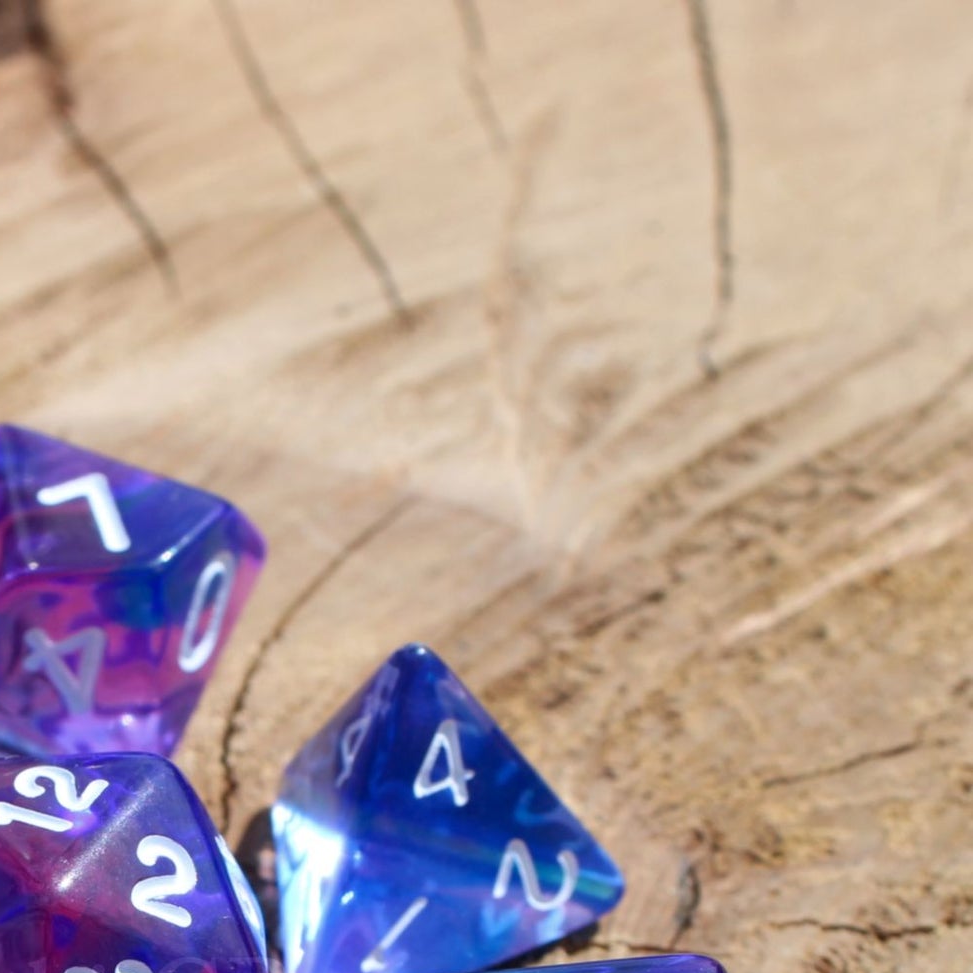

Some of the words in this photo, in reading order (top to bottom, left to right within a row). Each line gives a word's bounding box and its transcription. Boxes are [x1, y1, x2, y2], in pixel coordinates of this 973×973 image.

[177, 548, 236, 673] 0
[23, 626, 106, 714] 4
[413, 718, 475, 807] 4
[130, 834, 197, 928] 2
[493, 838, 578, 910] 2
